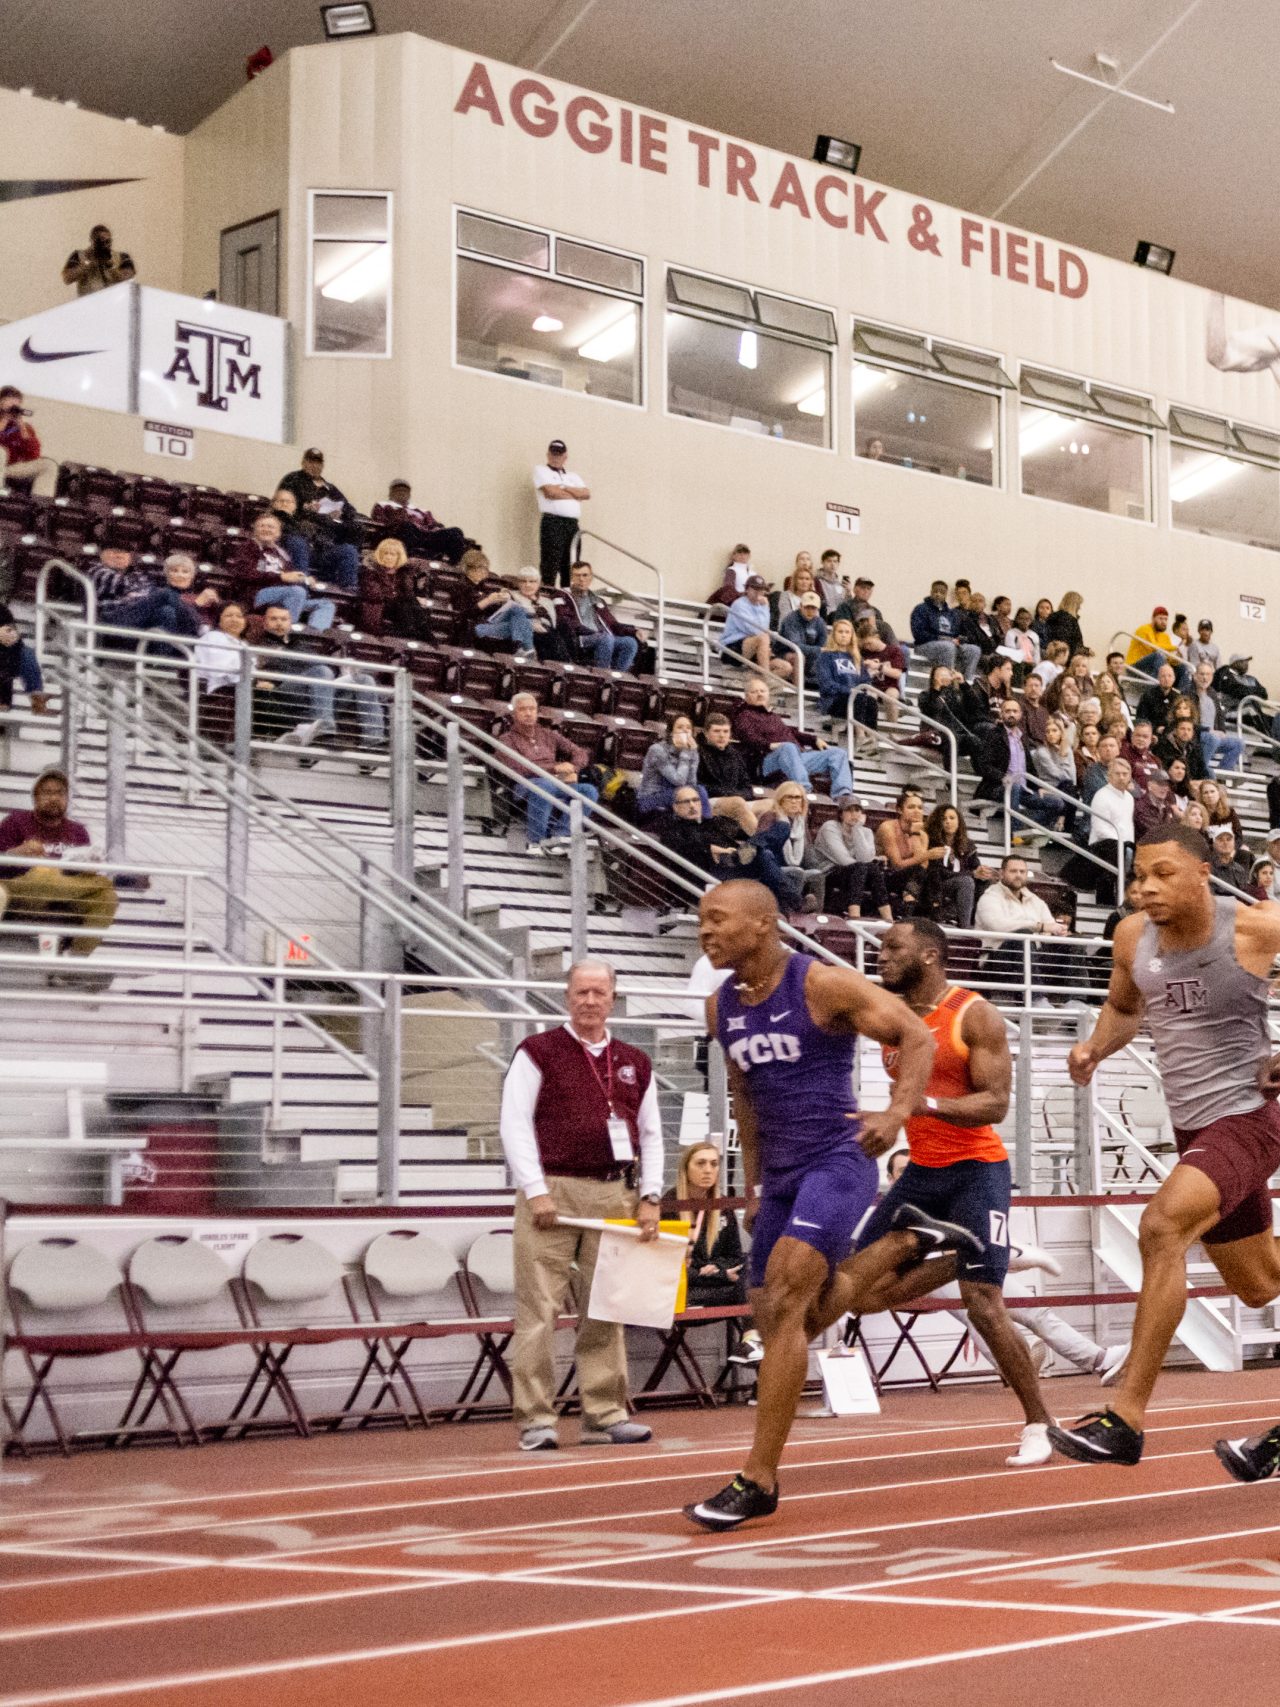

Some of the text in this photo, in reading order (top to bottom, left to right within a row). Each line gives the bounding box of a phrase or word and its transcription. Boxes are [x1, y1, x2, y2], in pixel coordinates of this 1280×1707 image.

[454, 61, 1089, 300] AGGIE TRACK & FIELD
[147, 422, 193, 437] SECTION
[156, 437, 187, 456] 10
[835, 514, 852, 531] 11
[1245, 605, 1262, 618] 12
[728, 1033, 801, 1072] TCU
[993, 1213, 1004, 1242] 7
